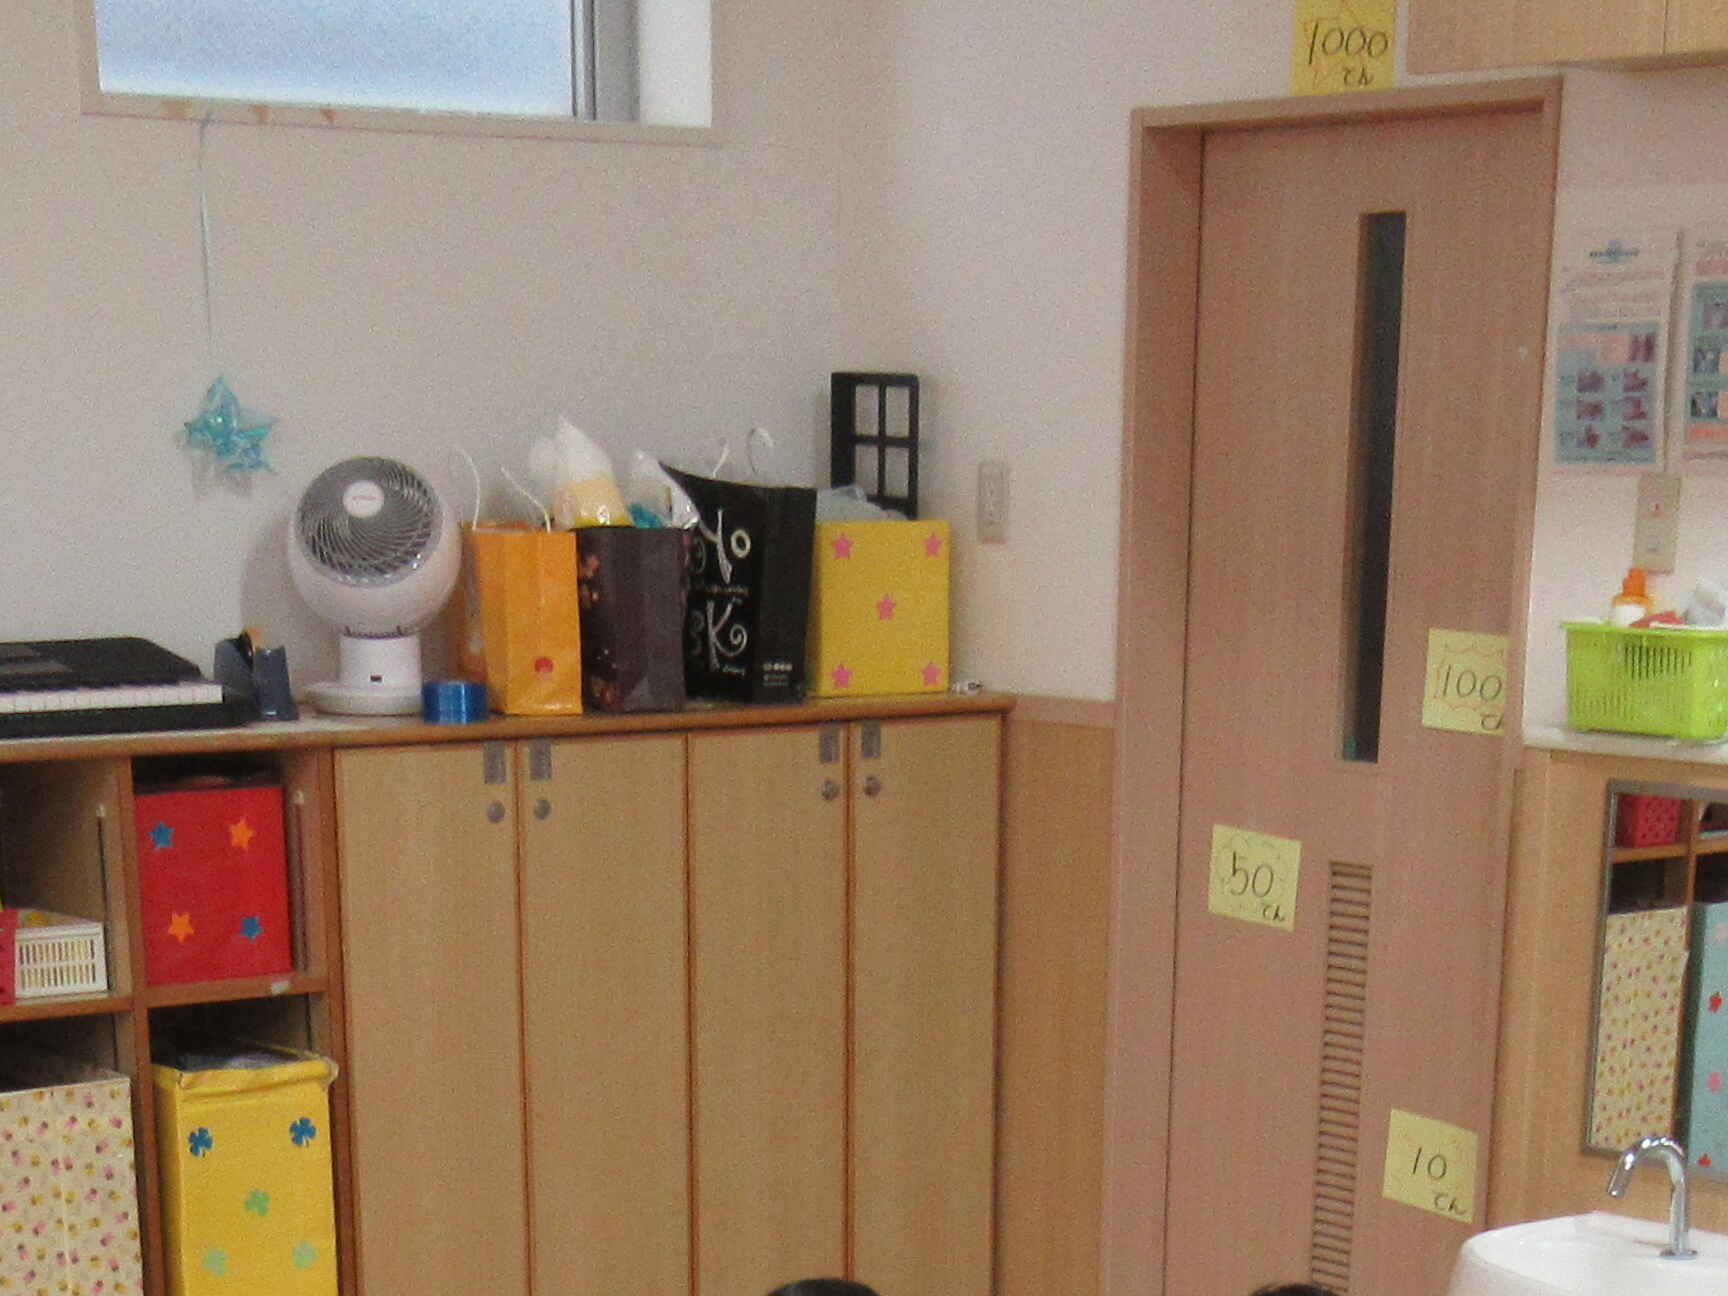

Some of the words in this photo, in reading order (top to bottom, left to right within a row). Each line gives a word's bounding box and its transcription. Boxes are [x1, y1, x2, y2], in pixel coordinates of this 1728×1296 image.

[1308, 20, 1389, 65] 1000
[1442, 664, 1503, 701] 100
[1228, 851, 1275, 899] 50
[1410, 1145, 1449, 1182] 10
